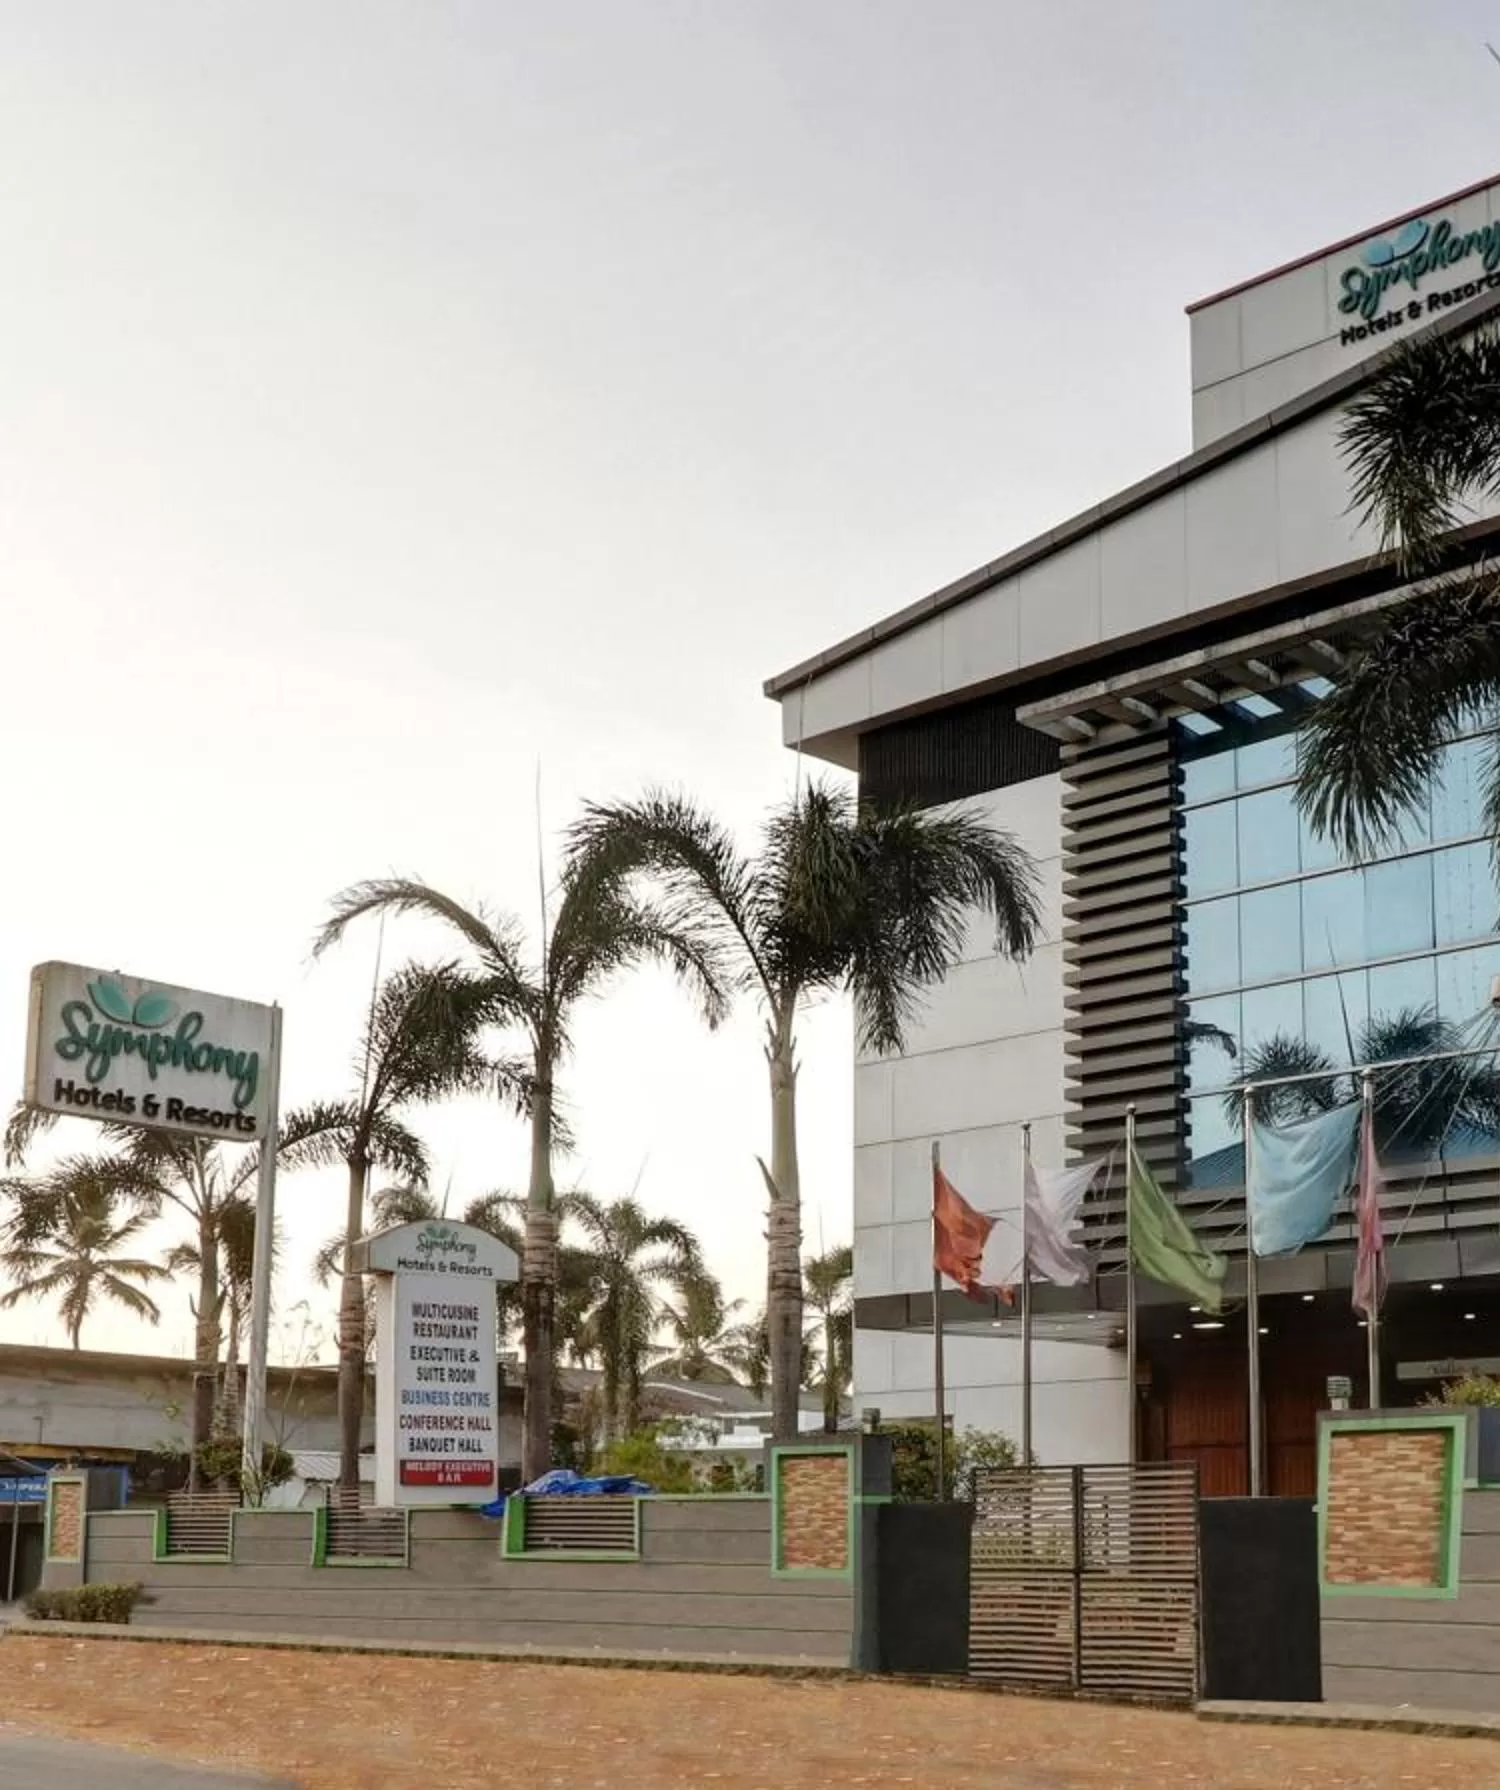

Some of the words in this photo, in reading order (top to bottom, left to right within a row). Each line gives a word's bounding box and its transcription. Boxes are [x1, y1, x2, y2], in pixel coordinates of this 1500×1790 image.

[1340, 310, 1403, 347] Hotels
[1408, 301, 1422, 320] &
[54, 1000, 259, 1109] Symphony
[54, 1078, 137, 1115] Hotels
[142, 1093, 161, 1120] &
[166, 1097, 257, 1133] Resorts
[416, 1231, 477, 1263] Symphony
[397, 1256, 435, 1272] Hotels
[437, 1261, 448, 1273] &
[450, 1261, 493, 1277] Resorts
[411, 1303, 480, 1321] MULTICUISINE
[413, 1322, 478, 1340] RESTAURANT
[409, 1345, 466, 1363] EXECUTIVE
[468, 1349, 481, 1363] &
[416, 1366, 446, 1383] SUITE
[447, 1367, 477, 1383] ROOM
[401, 1388, 450, 1407] BUSINESS
[452, 1391, 491, 1408] CENTRE
[399, 1414, 465, 1431] CONFERENCE
[467, 1415, 492, 1431] HALL
[409, 1437, 456, 1453] BANQUET
[458, 1437, 484, 1453] HALL
